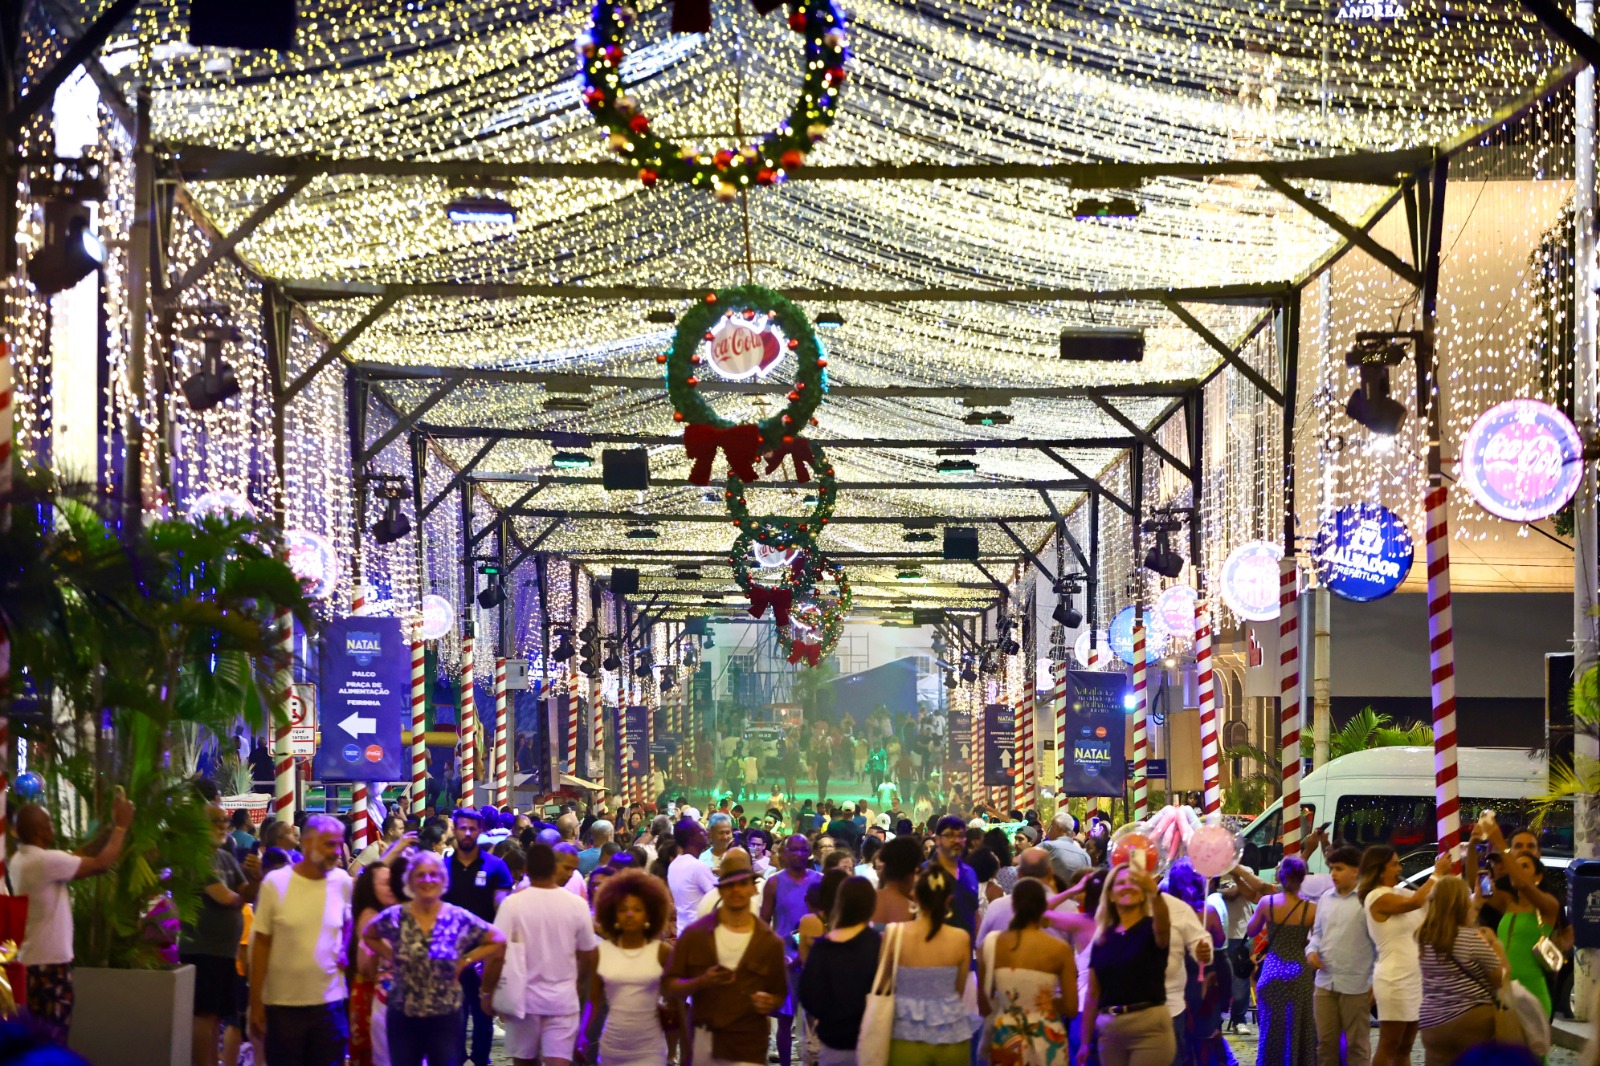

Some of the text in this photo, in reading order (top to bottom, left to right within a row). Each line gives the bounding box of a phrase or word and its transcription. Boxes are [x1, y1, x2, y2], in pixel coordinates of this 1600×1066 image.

[1337, 4, 1404, 18] ANDREA
[346, 639, 381, 650] NATAL
[1075, 747, 1111, 760] NATAL
